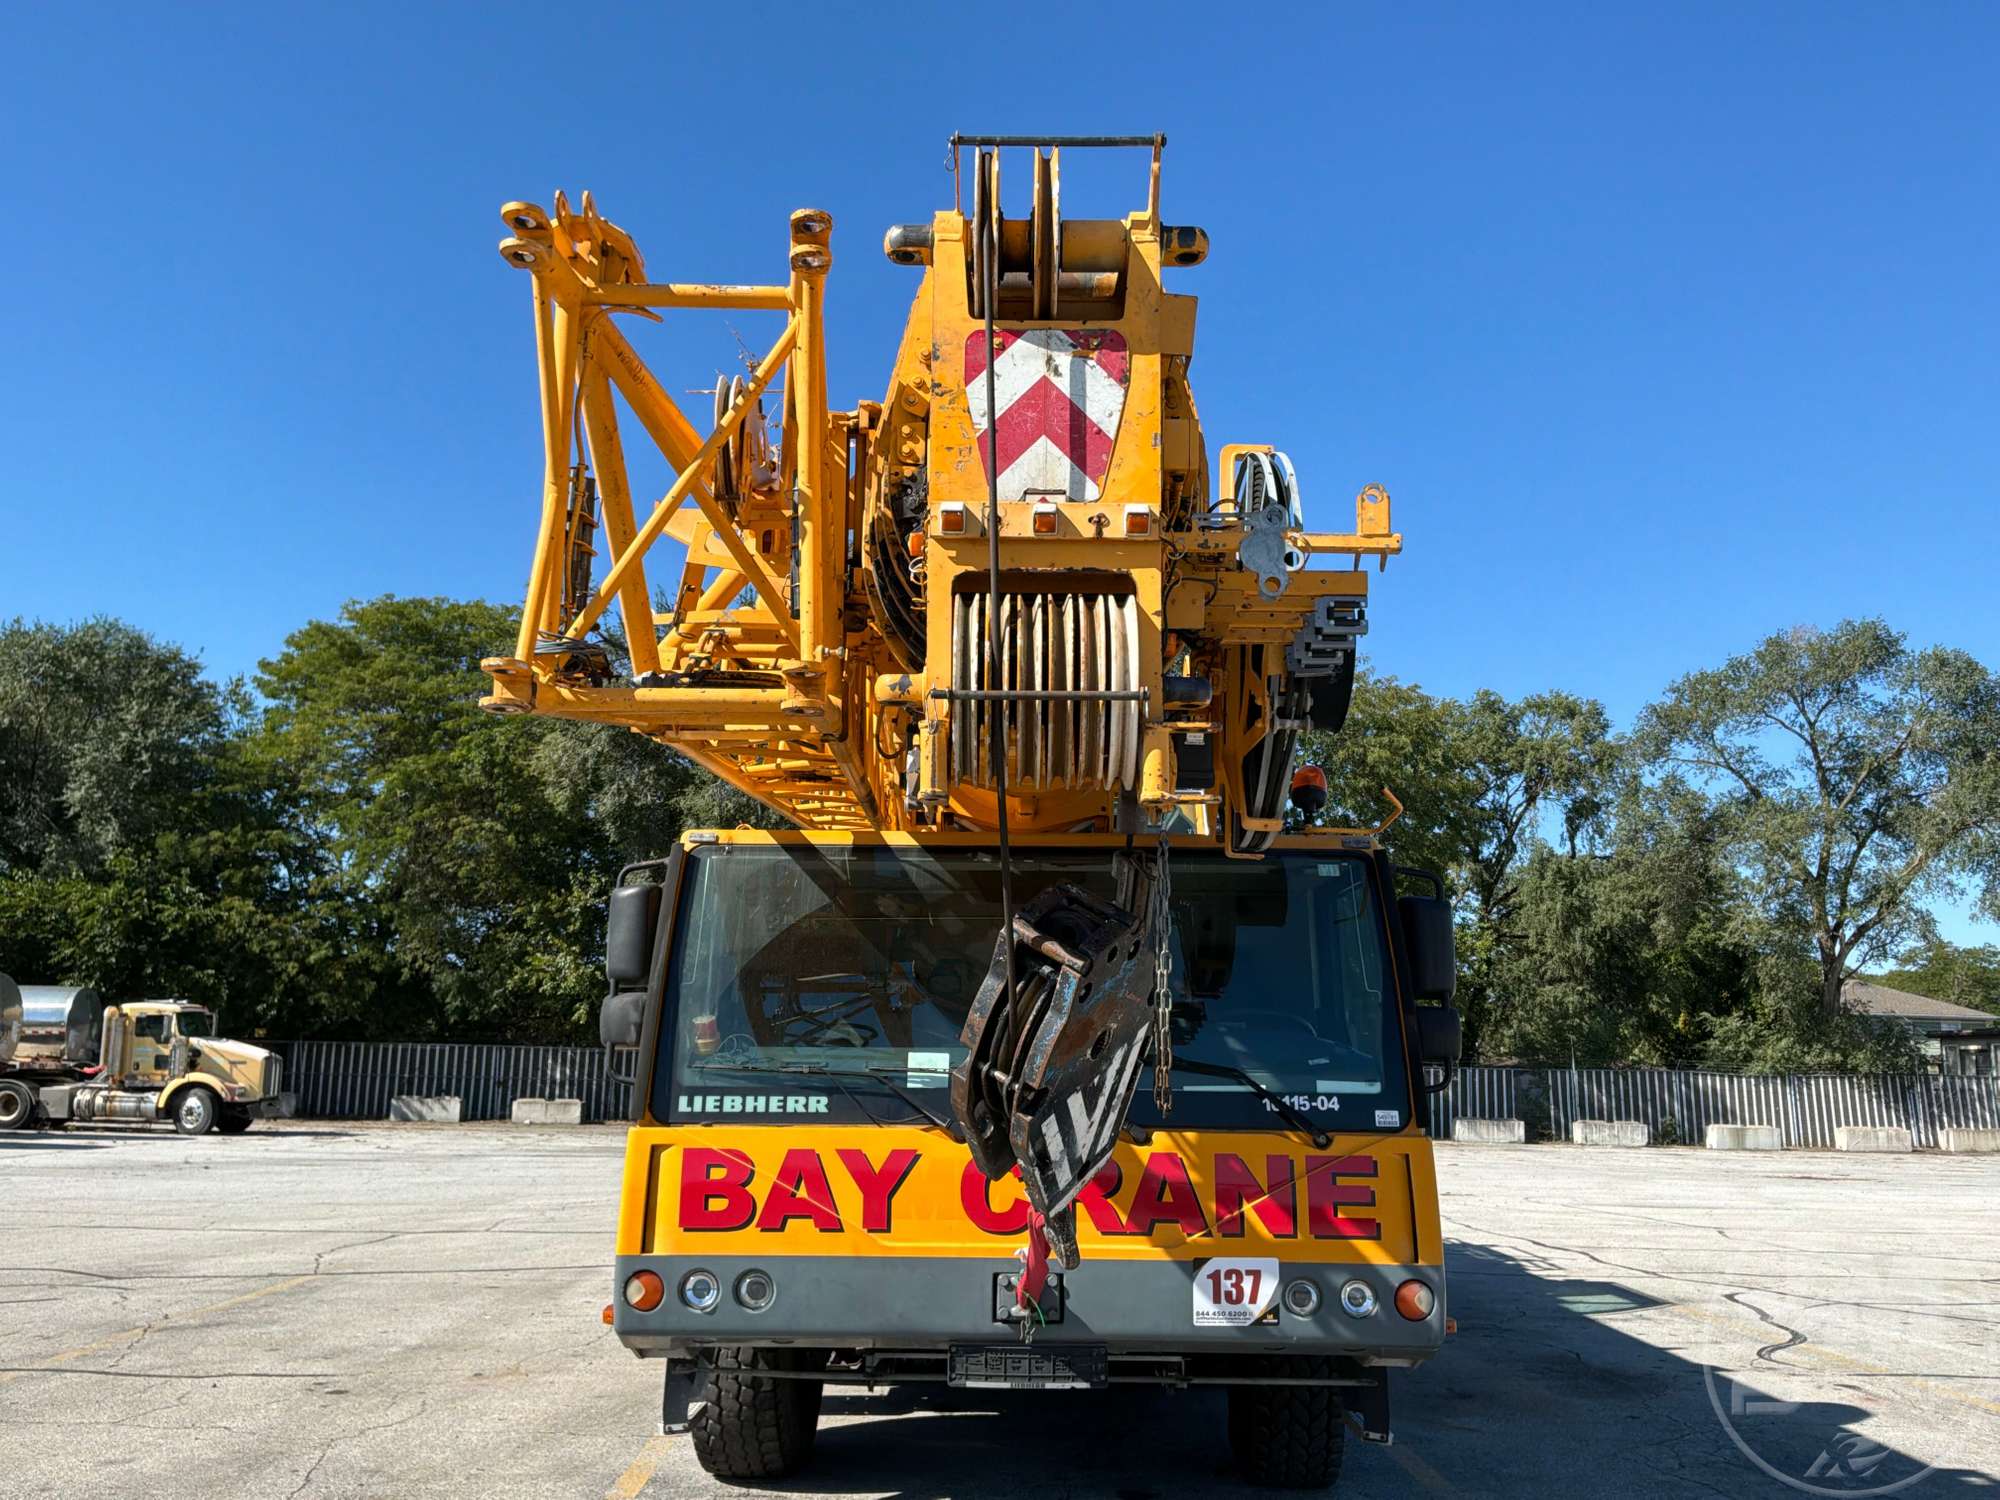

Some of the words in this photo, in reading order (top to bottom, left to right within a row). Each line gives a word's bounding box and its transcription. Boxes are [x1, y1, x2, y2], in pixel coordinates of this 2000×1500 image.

[678, 1095, 829, 1113] LIEBHERR
[678, 1147, 922, 1233] BAY
[960, 1151, 1382, 1240] CRANE
[1206, 1268, 1262, 1305] 137
